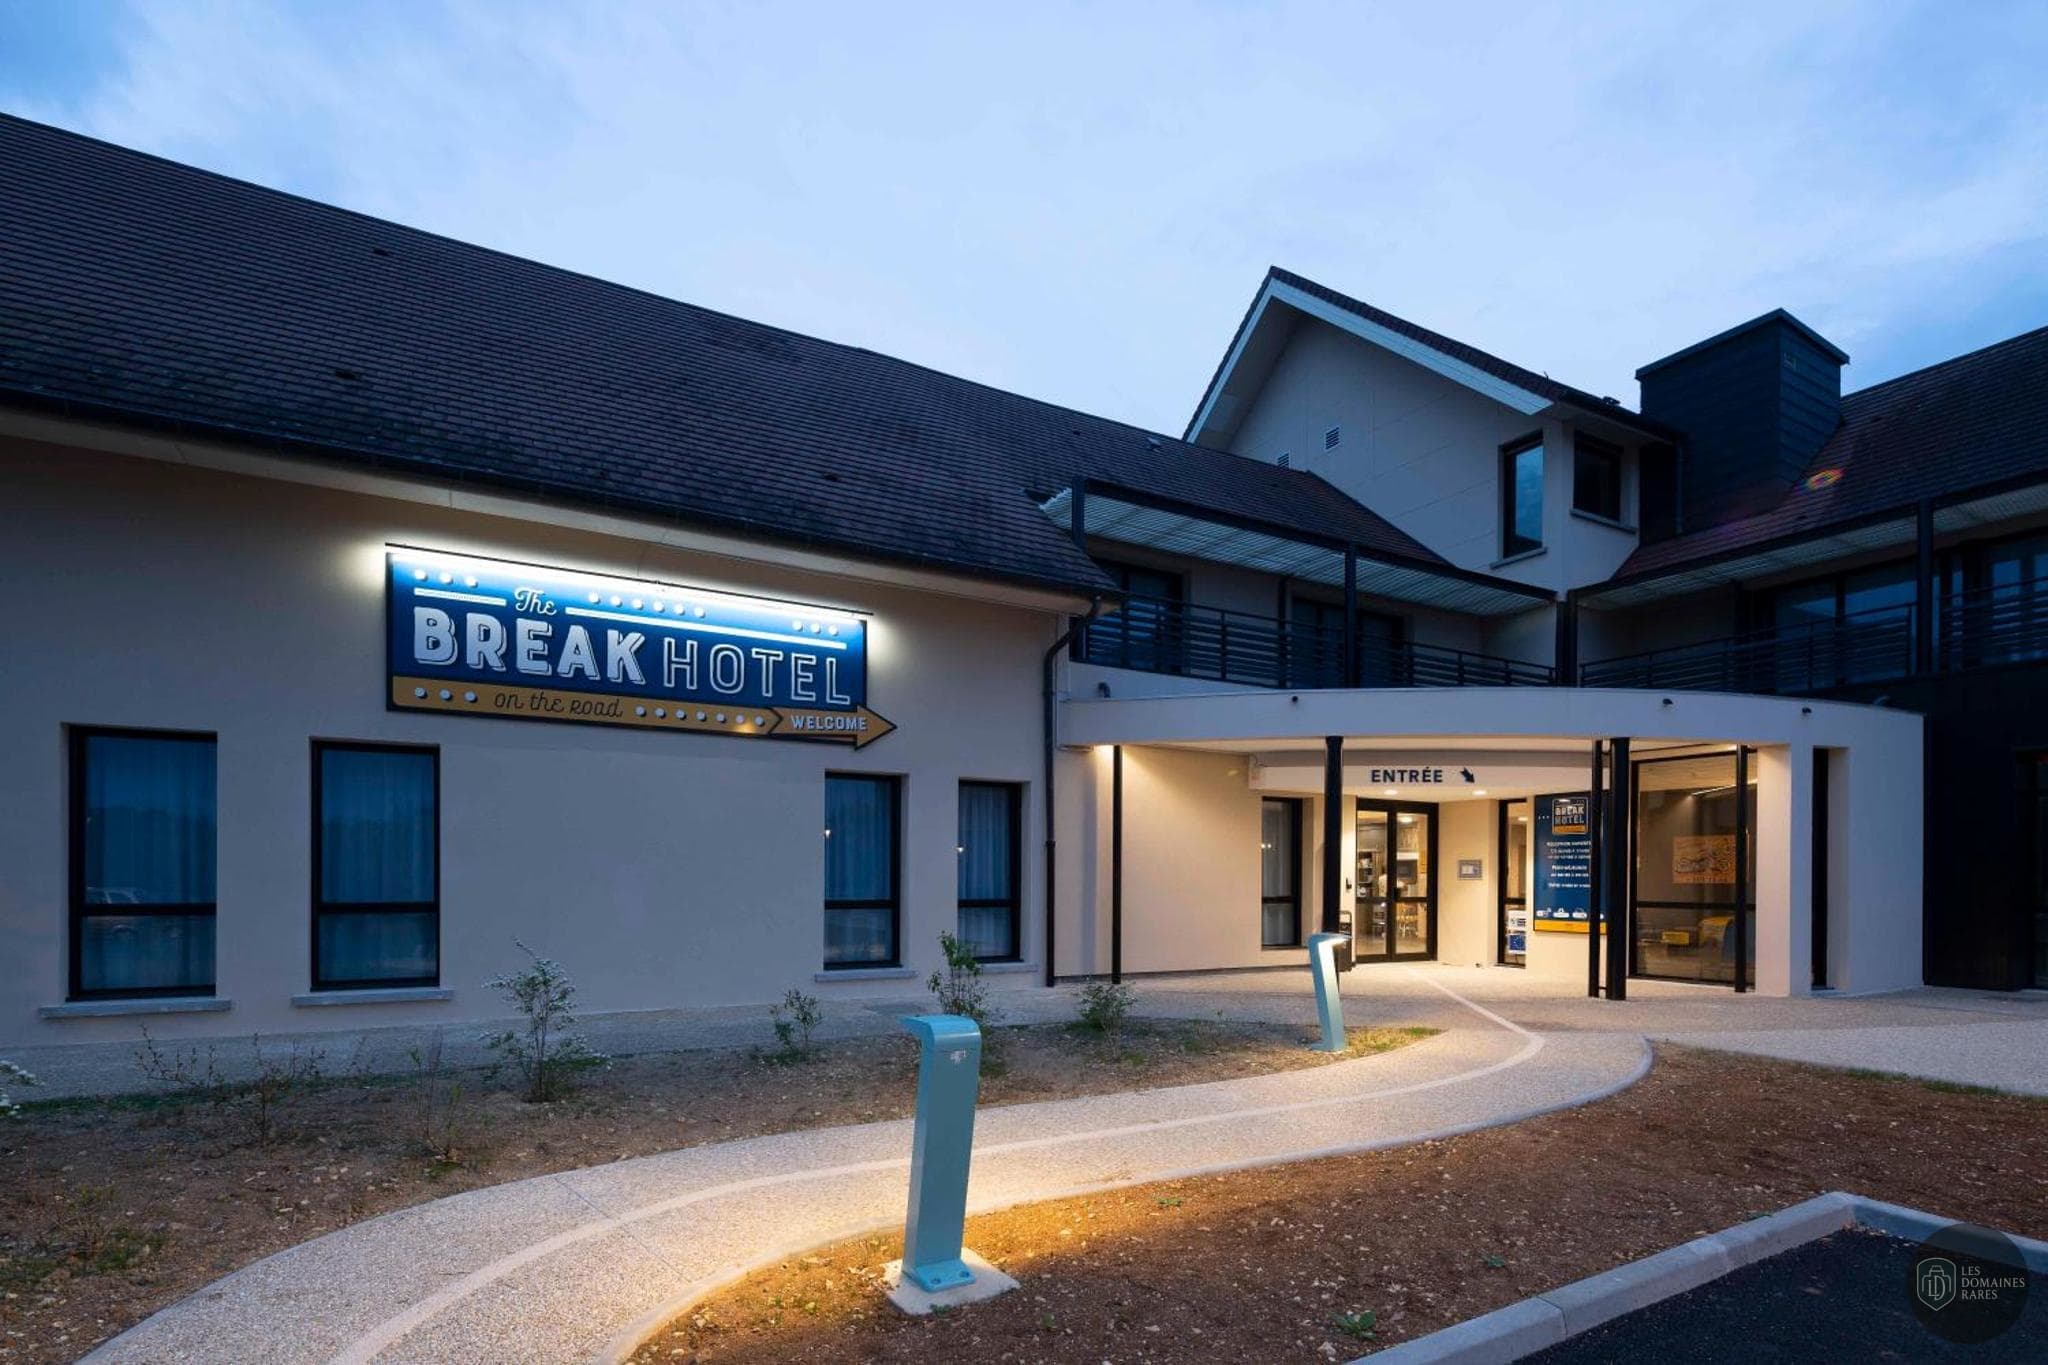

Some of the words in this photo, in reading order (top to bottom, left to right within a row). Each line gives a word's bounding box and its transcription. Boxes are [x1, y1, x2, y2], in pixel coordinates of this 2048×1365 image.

[514, 586, 557, 616] The
[413, 606, 647, 685] BREAK
[662, 636, 851, 705] HOTEL
[493, 692, 525, 710] on
[530, 692, 565, 713] the
[791, 714, 868, 731] WELCOME
[1370, 766, 1444, 783] ENTRÉE
[1555, 806, 1585, 816] BREAK
[1555, 815, 1585, 824] HOTEL
